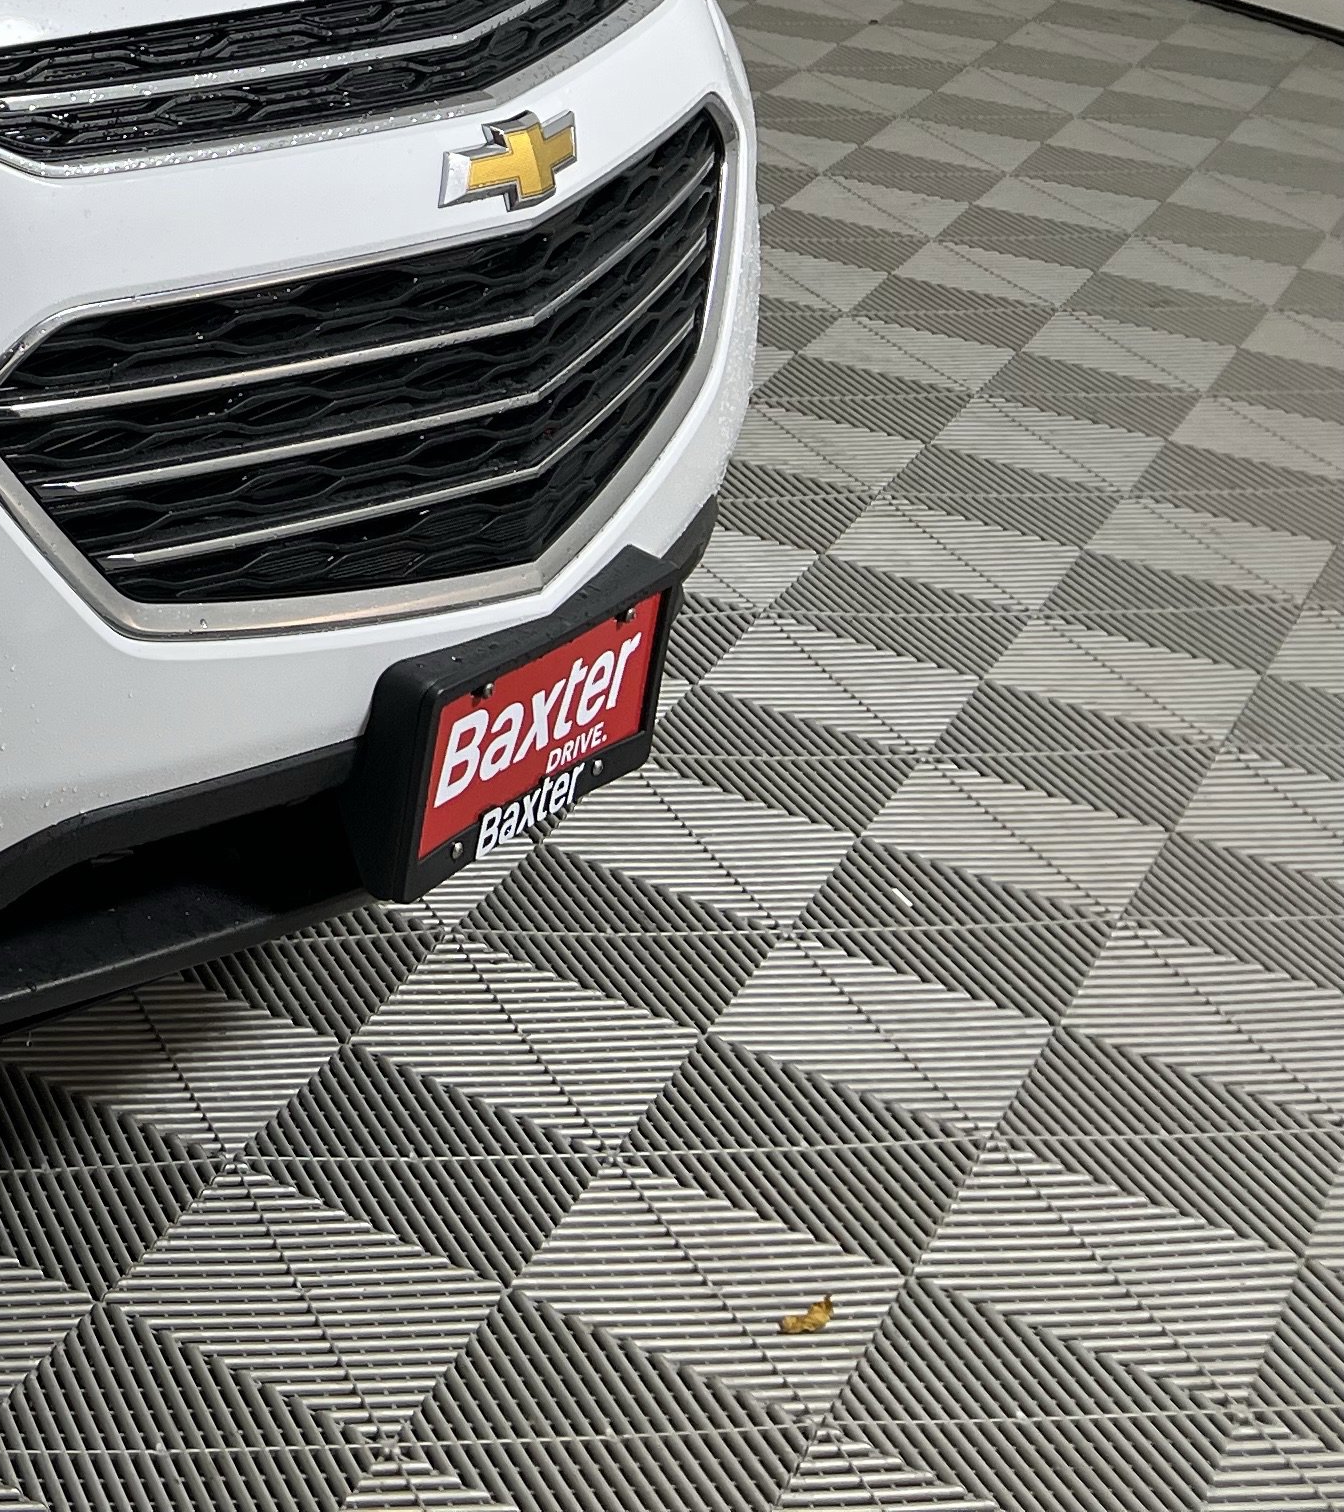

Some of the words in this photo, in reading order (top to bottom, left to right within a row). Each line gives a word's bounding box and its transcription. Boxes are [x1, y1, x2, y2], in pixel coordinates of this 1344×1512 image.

[433, 631, 642, 808] Baxter
[545, 721, 608, 774] DRIVE.
[475, 762, 586, 860] Baxter
